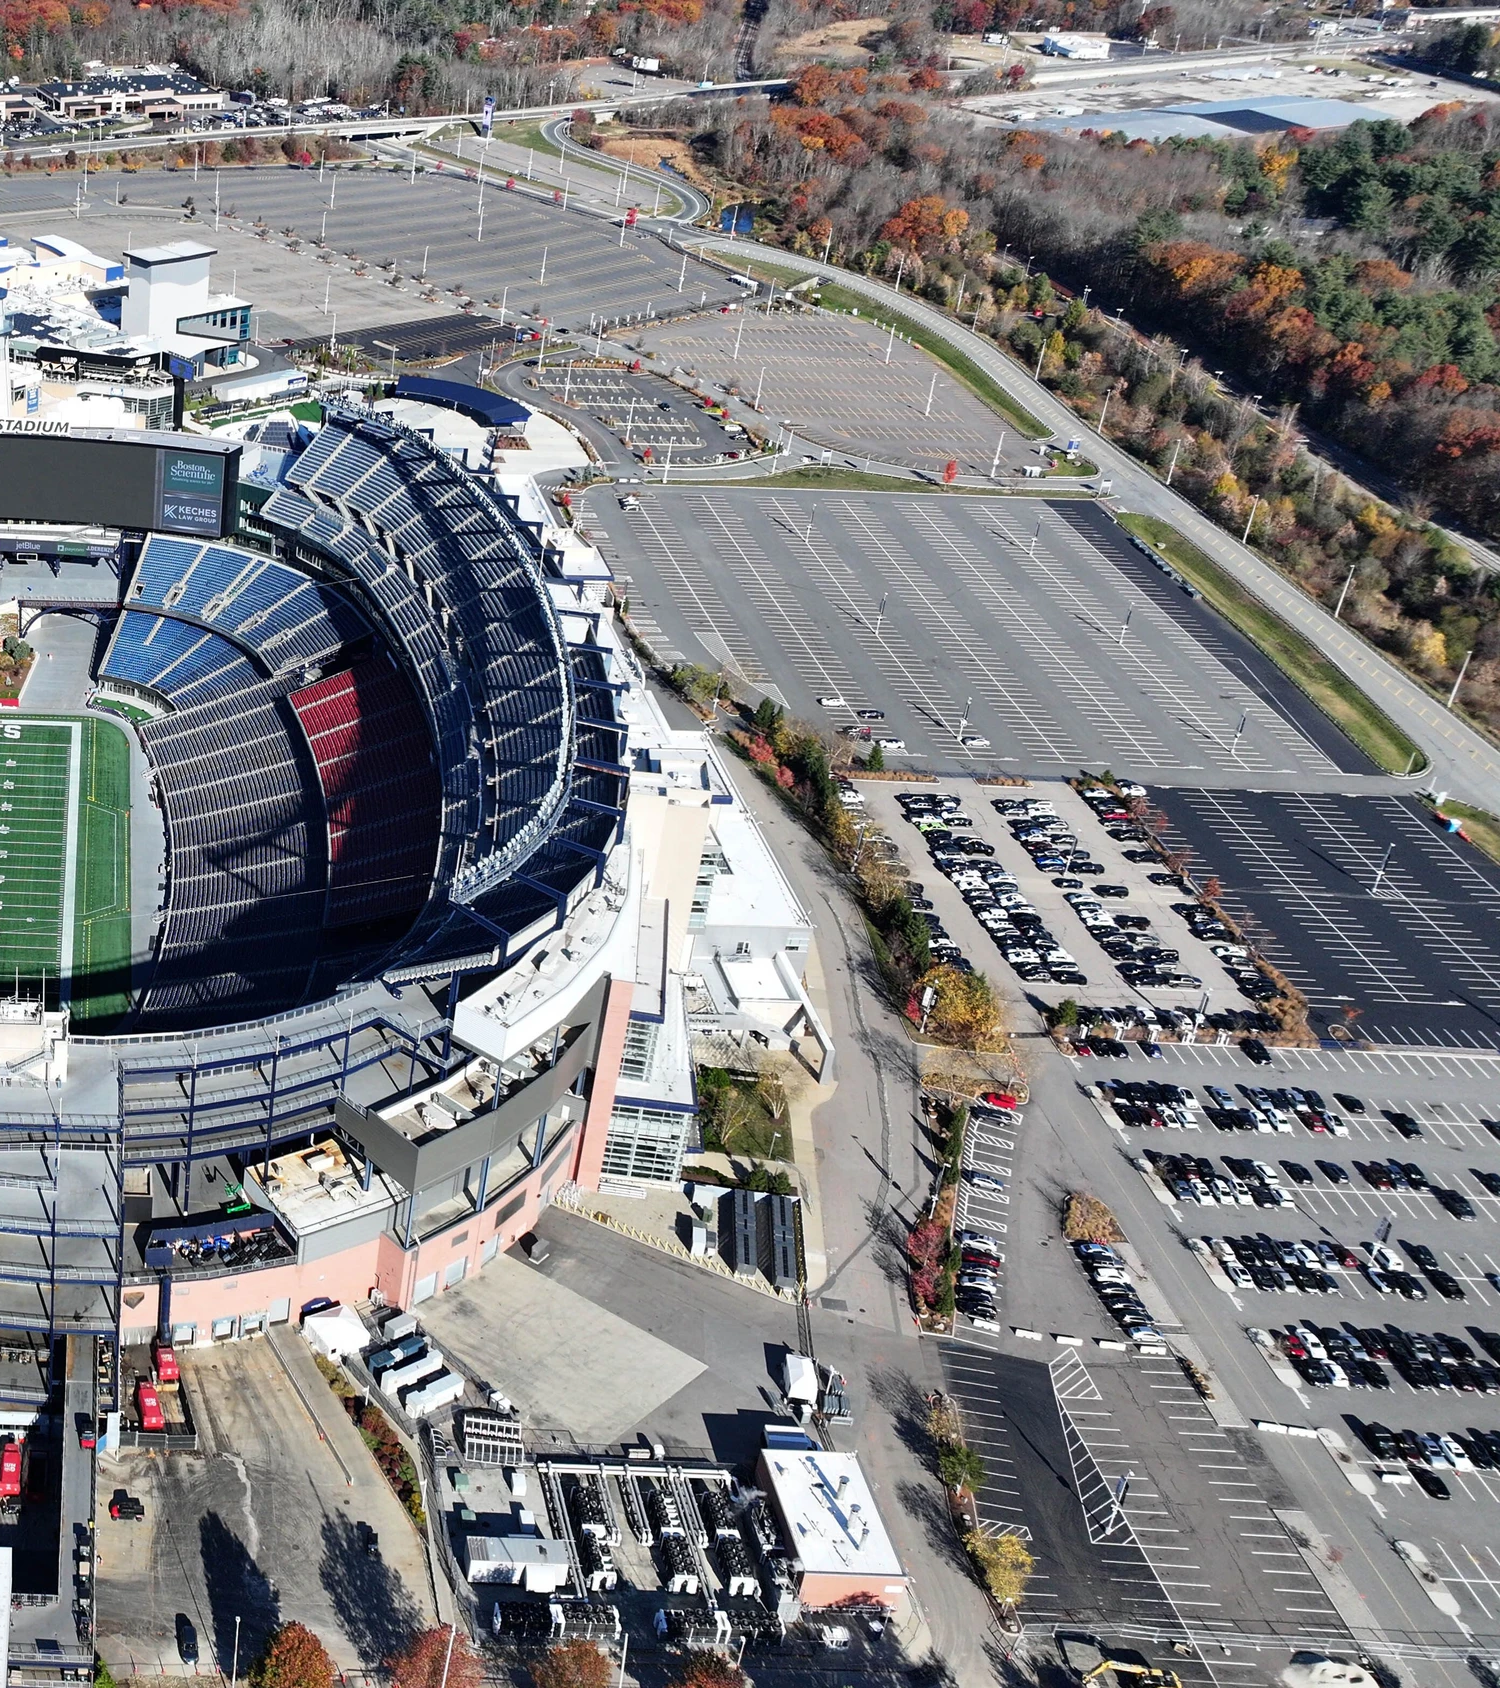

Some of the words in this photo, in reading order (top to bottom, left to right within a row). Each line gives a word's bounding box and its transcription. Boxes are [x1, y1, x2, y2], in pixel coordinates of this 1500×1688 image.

[177, 460, 205, 472] Boston
[170, 465, 216, 481] Scientific
[179, 506, 216, 517] KECHES
[16, 541, 41, 550] jetBlue
